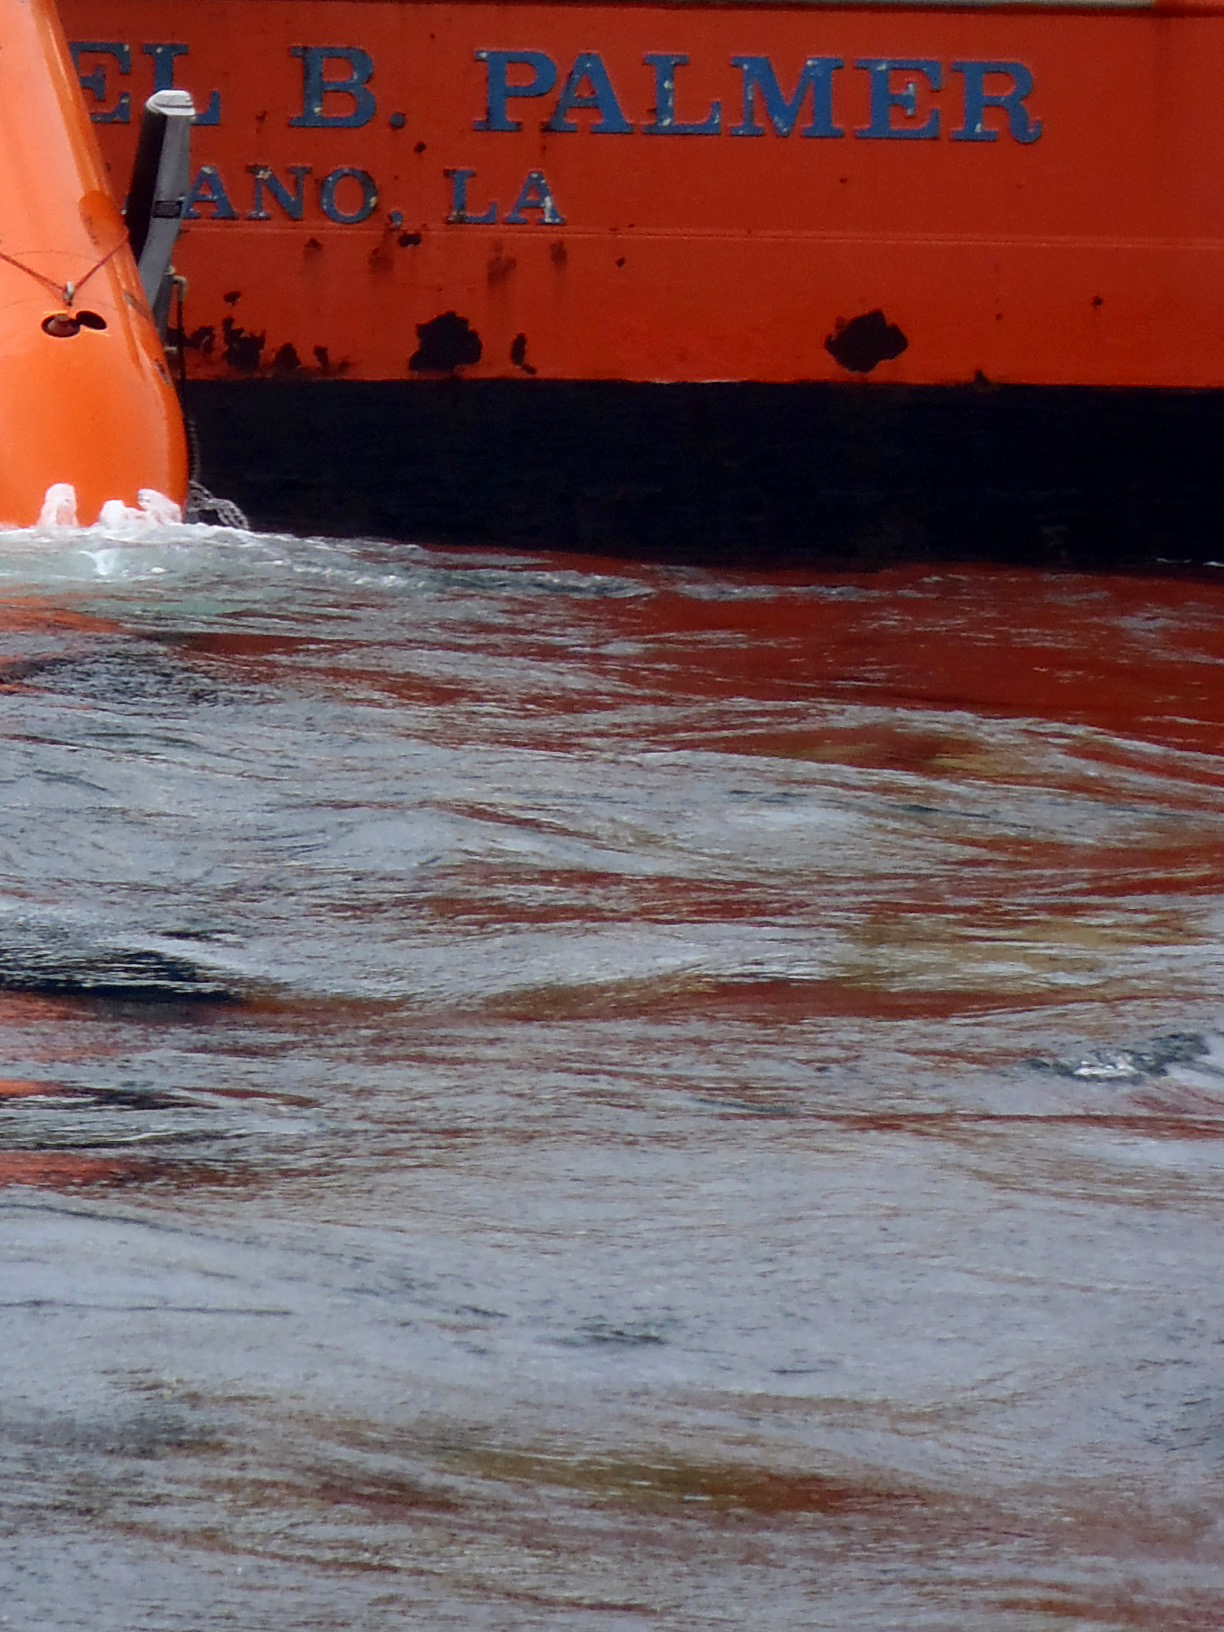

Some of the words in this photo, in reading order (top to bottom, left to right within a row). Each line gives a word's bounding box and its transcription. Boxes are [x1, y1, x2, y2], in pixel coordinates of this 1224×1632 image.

[289, 45, 406, 128] B.
[473, 49, 1043, 145] PALMER
[444, 168, 565, 225] LA
